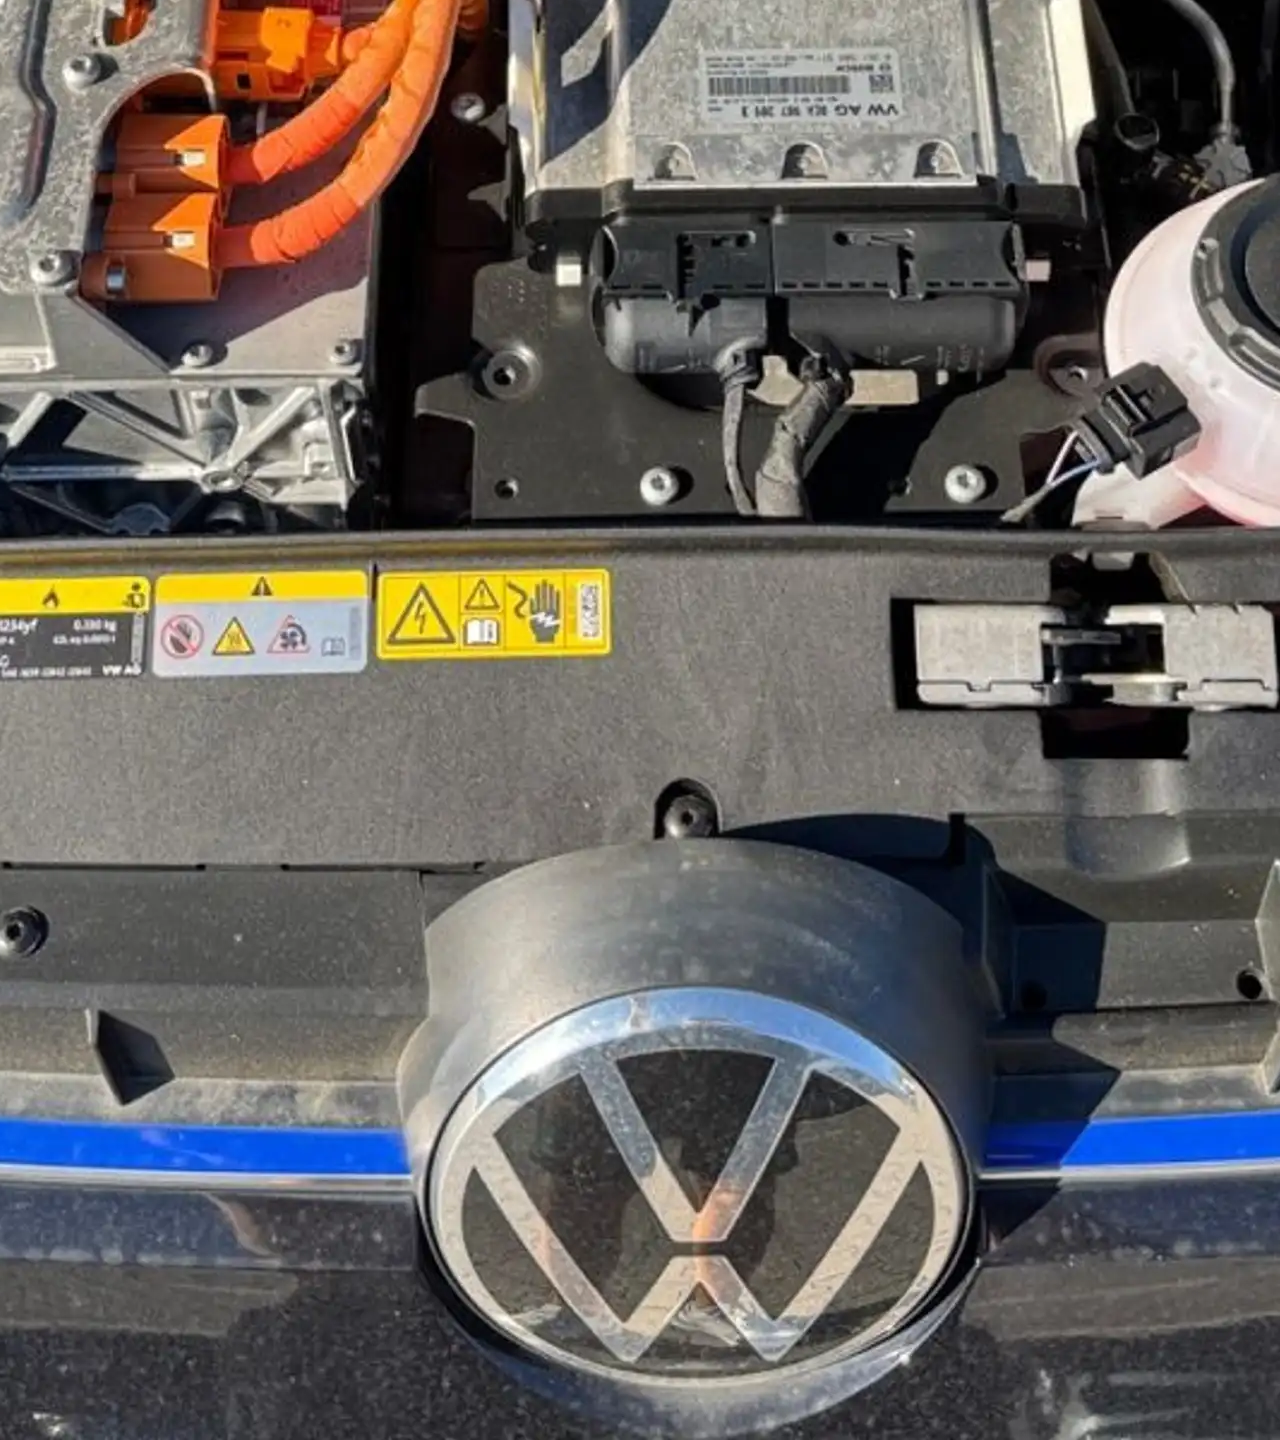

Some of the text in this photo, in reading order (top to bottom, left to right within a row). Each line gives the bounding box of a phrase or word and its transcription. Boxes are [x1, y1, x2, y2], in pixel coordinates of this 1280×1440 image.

[834, 104, 862, 116] AG
[868, 103, 899, 116] VW
[102, 663, 123, 676] VW
